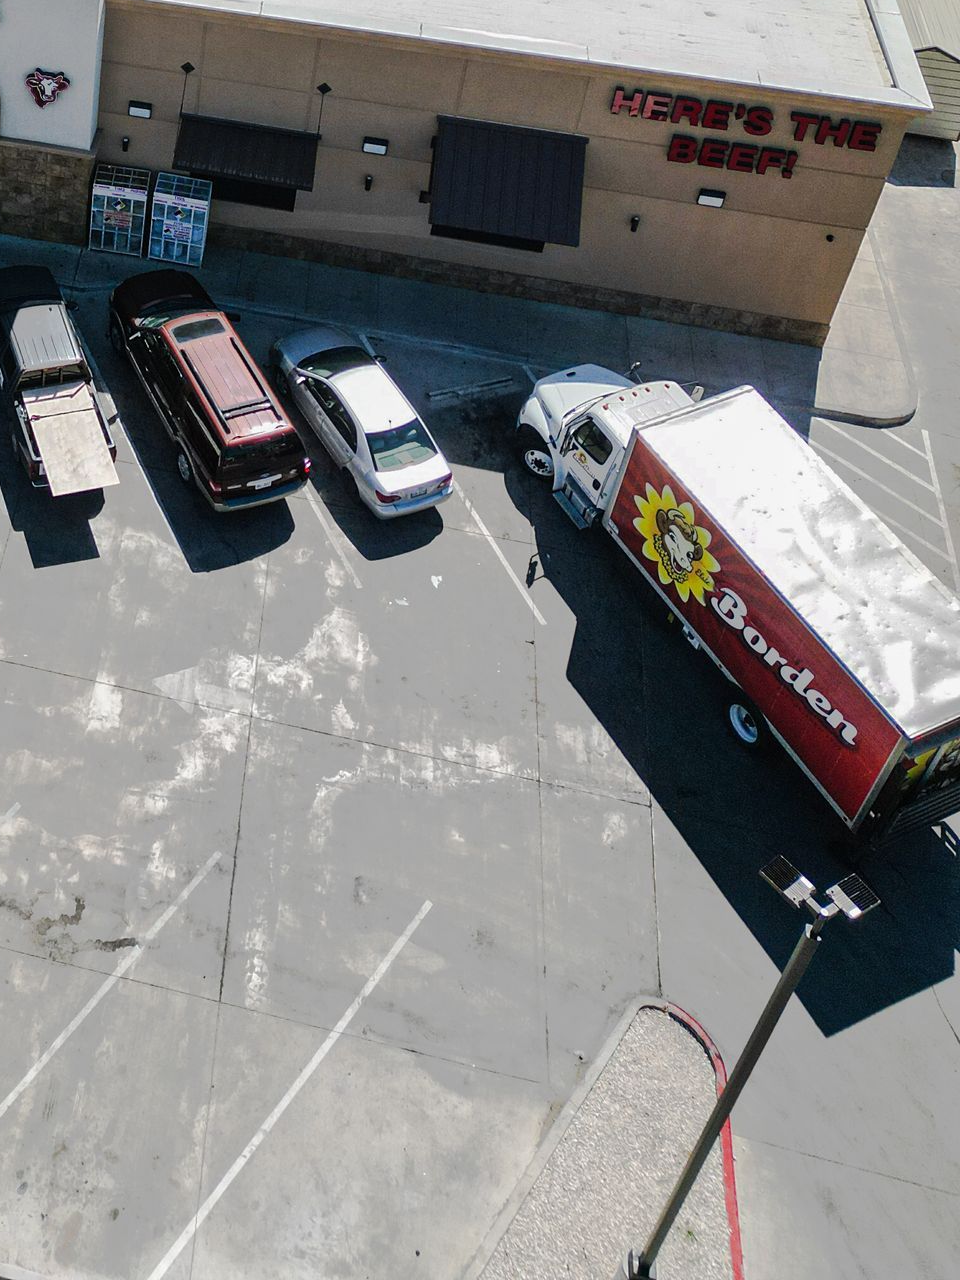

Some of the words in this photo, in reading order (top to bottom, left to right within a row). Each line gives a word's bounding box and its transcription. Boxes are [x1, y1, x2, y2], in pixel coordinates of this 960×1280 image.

[611, 86, 774, 136] HERE'S
[790, 111, 882, 152] THE
[667, 134, 800, 179] BEEF!
[710, 587, 858, 746] Borden
